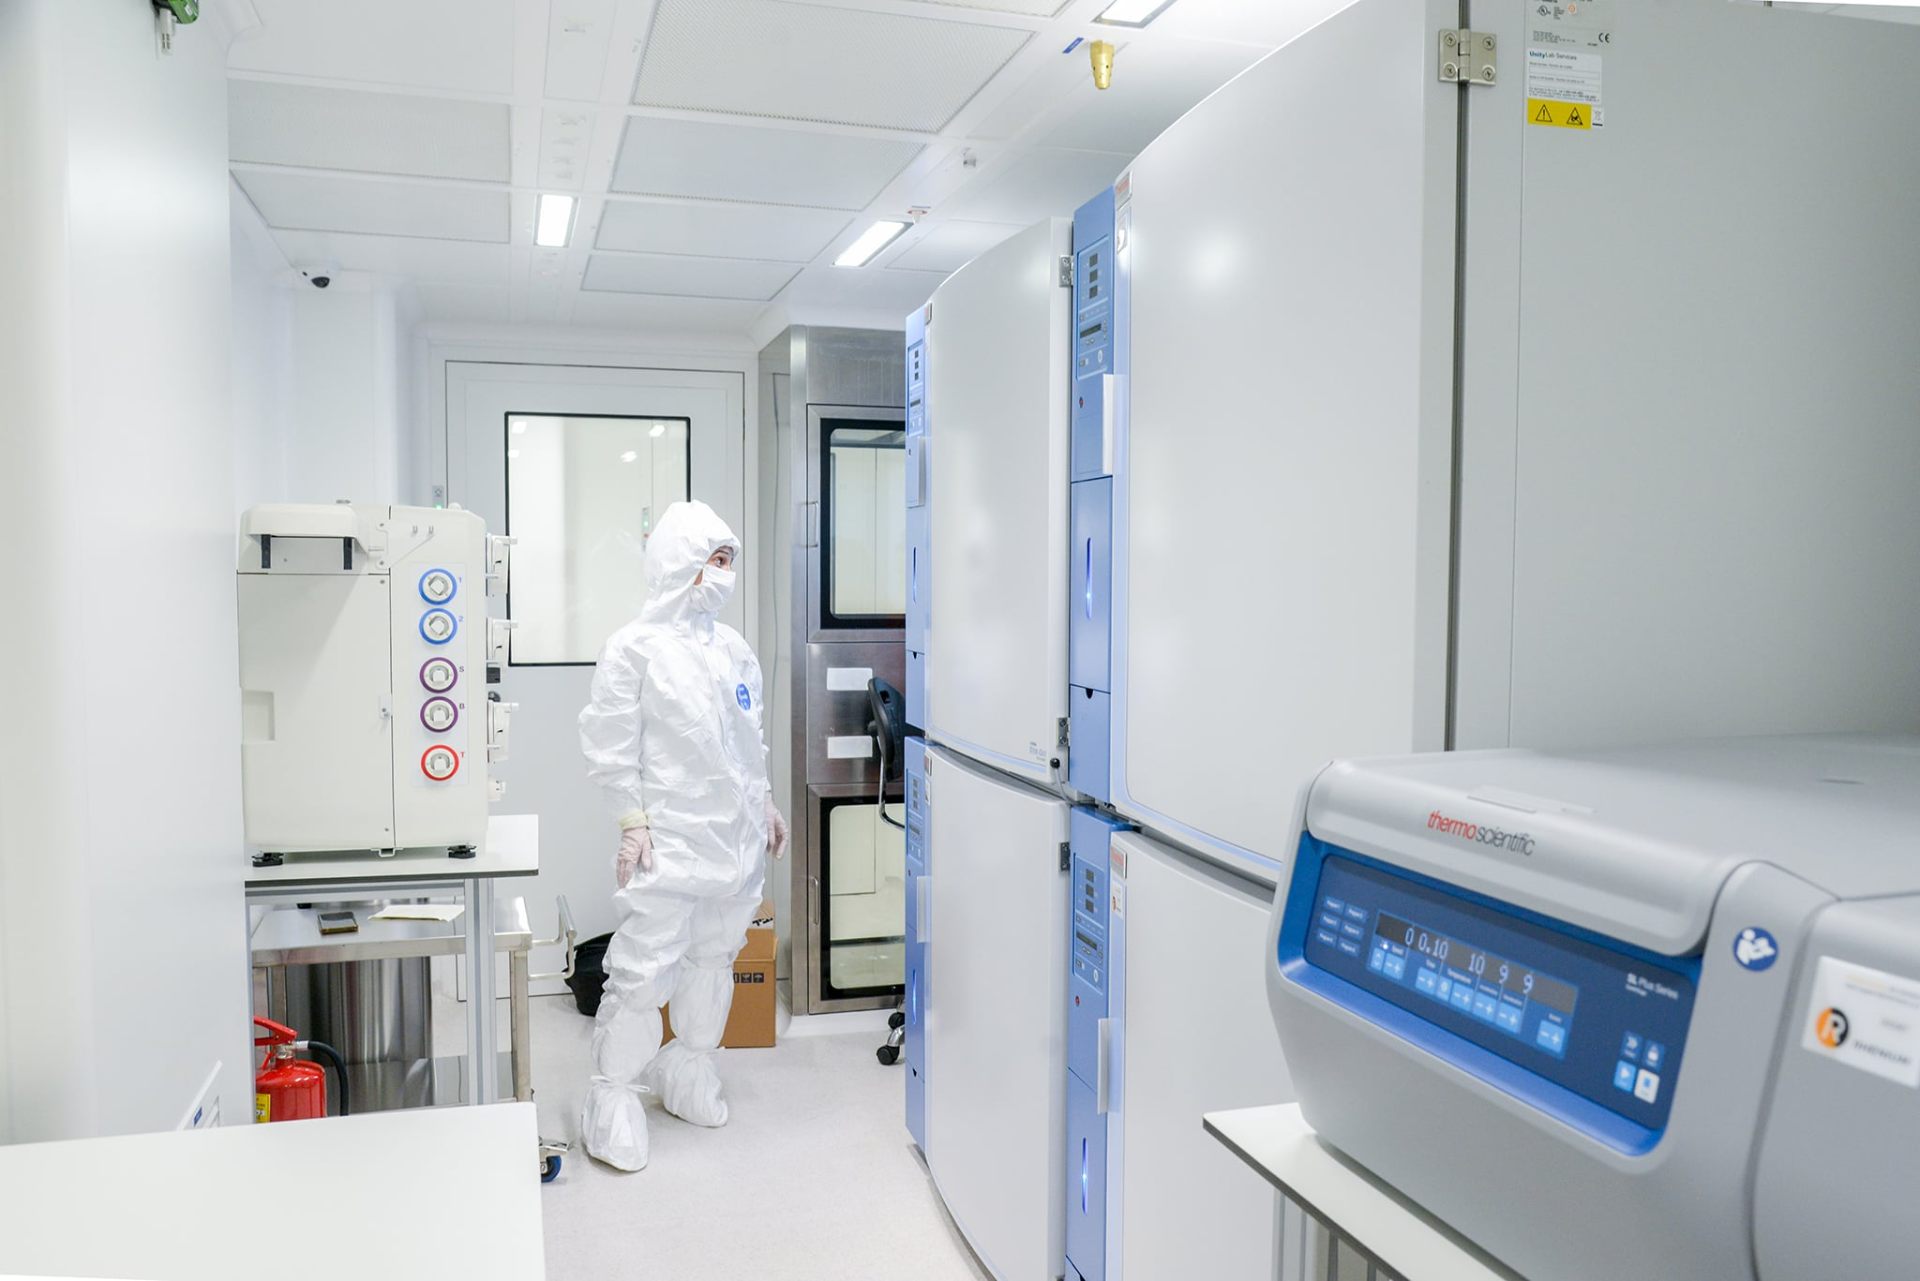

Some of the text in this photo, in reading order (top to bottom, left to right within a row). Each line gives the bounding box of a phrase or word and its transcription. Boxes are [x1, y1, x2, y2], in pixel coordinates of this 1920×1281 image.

[1418, 932, 1449, 960] 0.10
[1468, 953, 1486, 976] 10
[1499, 964, 1510, 984] 9
[1523, 973, 1534, 995] 9
